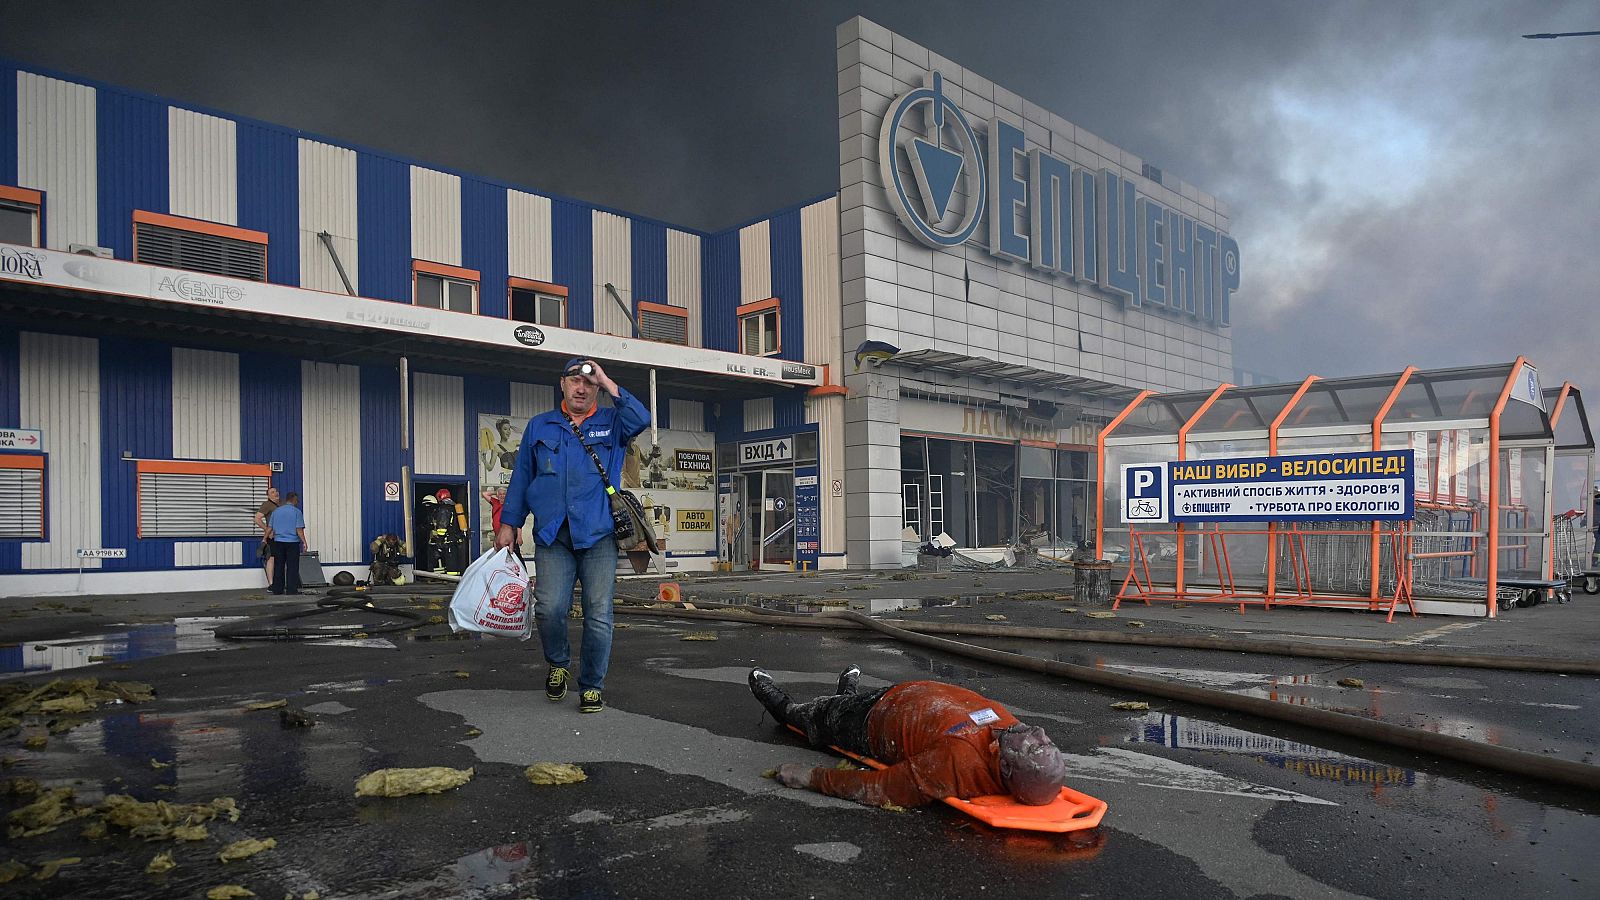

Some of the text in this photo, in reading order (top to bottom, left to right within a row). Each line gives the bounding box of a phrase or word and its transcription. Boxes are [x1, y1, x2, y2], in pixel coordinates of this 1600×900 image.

[988, 114, 1241, 328] ЕПІЦЕНТР
[678, 452, 711, 461] ПОБУТОВА
[744, 444, 775, 460] ВХІД
[678, 461, 711, 470] ТЕХНІКА
[1173, 465, 1211, 481] НАШ
[1215, 463, 1267, 479] ВИБІР
[1281, 456, 1406, 477] ВЕЛОСИПЕД!
[1134, 470, 1155, 497] P
[1183, 486, 1241, 498] АКТИВНИЙ
[1242, 486, 1283, 497] СПОСІБ
[1284, 485, 1327, 496] ЖИТТЯ
[1192, 501, 1400, 513] ЕПІЦЕНТР ТУРБОТА ПРО ЕКОЛОГІЮ
[685, 512, 706, 520] АВТО
[680, 521, 711, 530] ТОВАРИ
